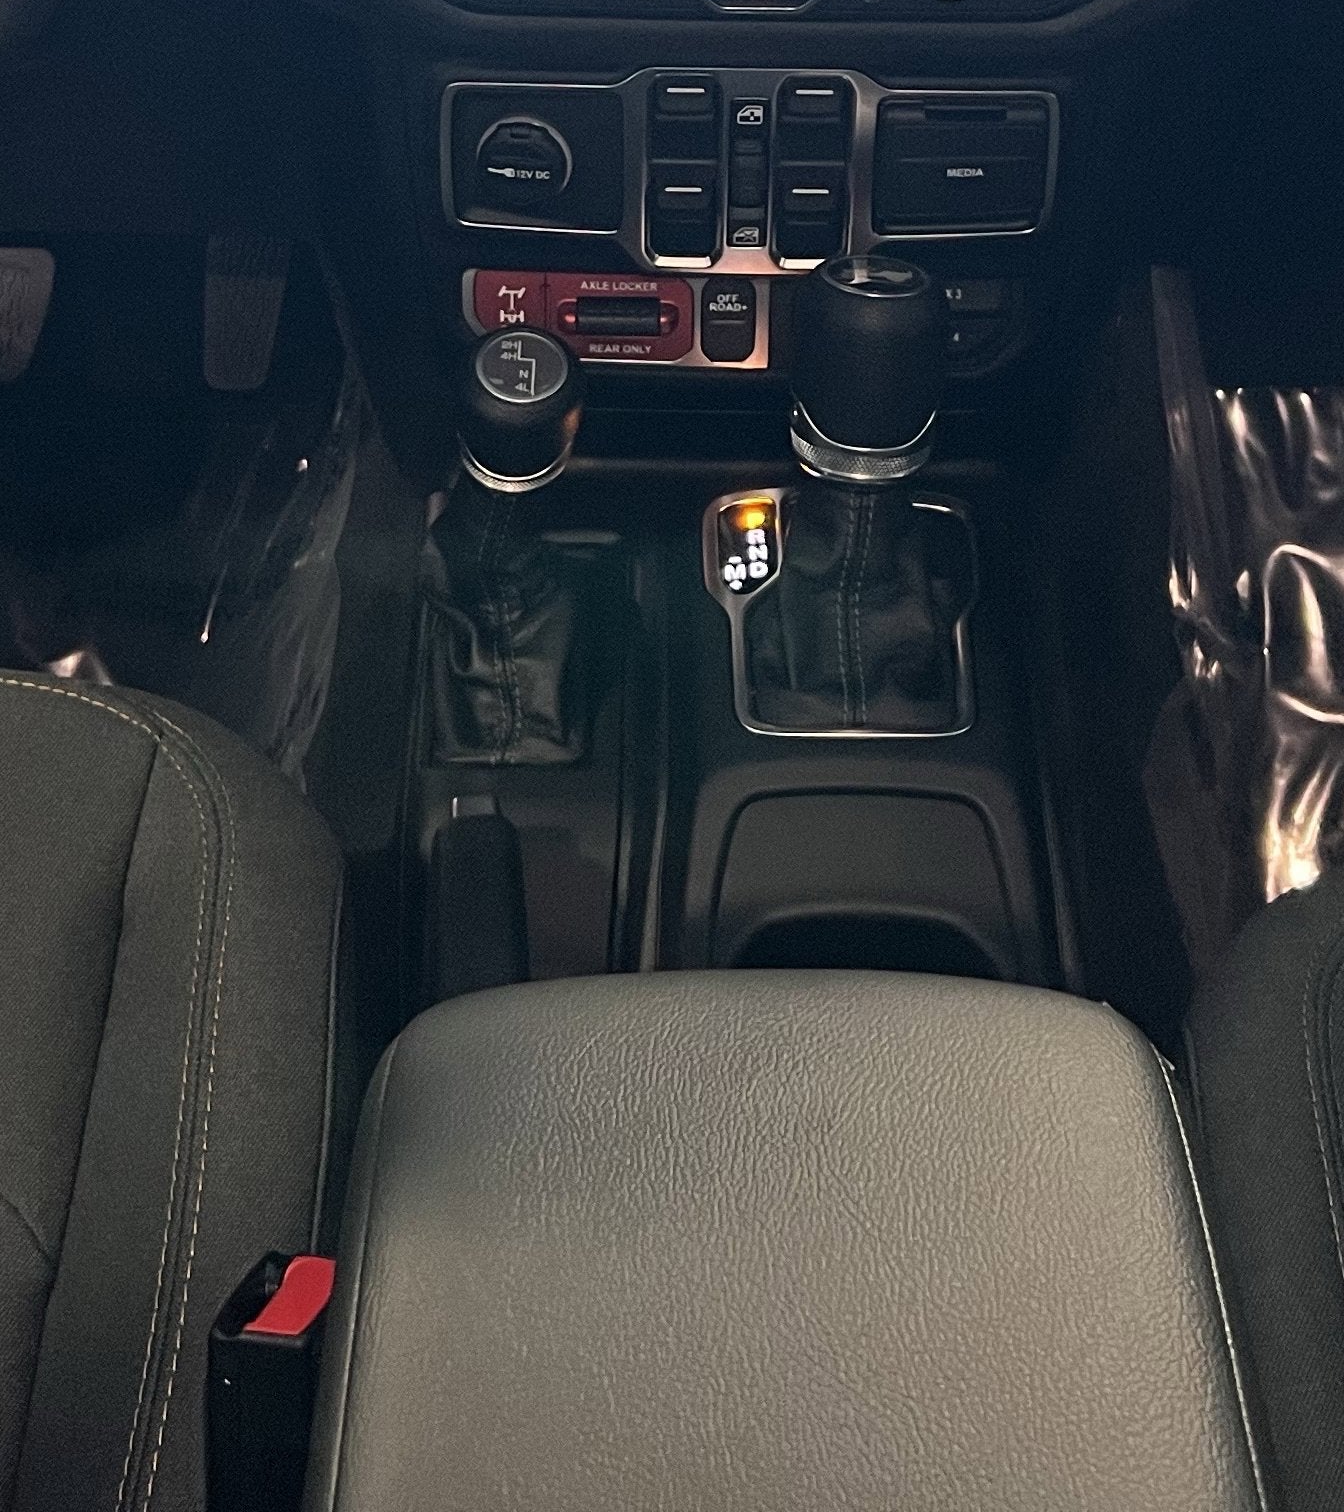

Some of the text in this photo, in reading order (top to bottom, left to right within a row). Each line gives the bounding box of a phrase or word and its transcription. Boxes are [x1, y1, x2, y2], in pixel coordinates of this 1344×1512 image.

[516, 169, 551, 180] 12V DC
[946, 167, 984, 178] MEDIA
[580, 281, 658, 292] AXLE LOCKER
[716, 294, 739, 304] OFF
[709, 302, 748, 313] ROAD+
[589, 343, 652, 355] REAR ONLY
[499, 351, 518, 361] 4H
[518, 369, 529, 379] N
[746, 528, 766, 545] R
[747, 544, 768, 561] N
[723, 563, 747, 582] M
[748, 561, 769, 579] D
